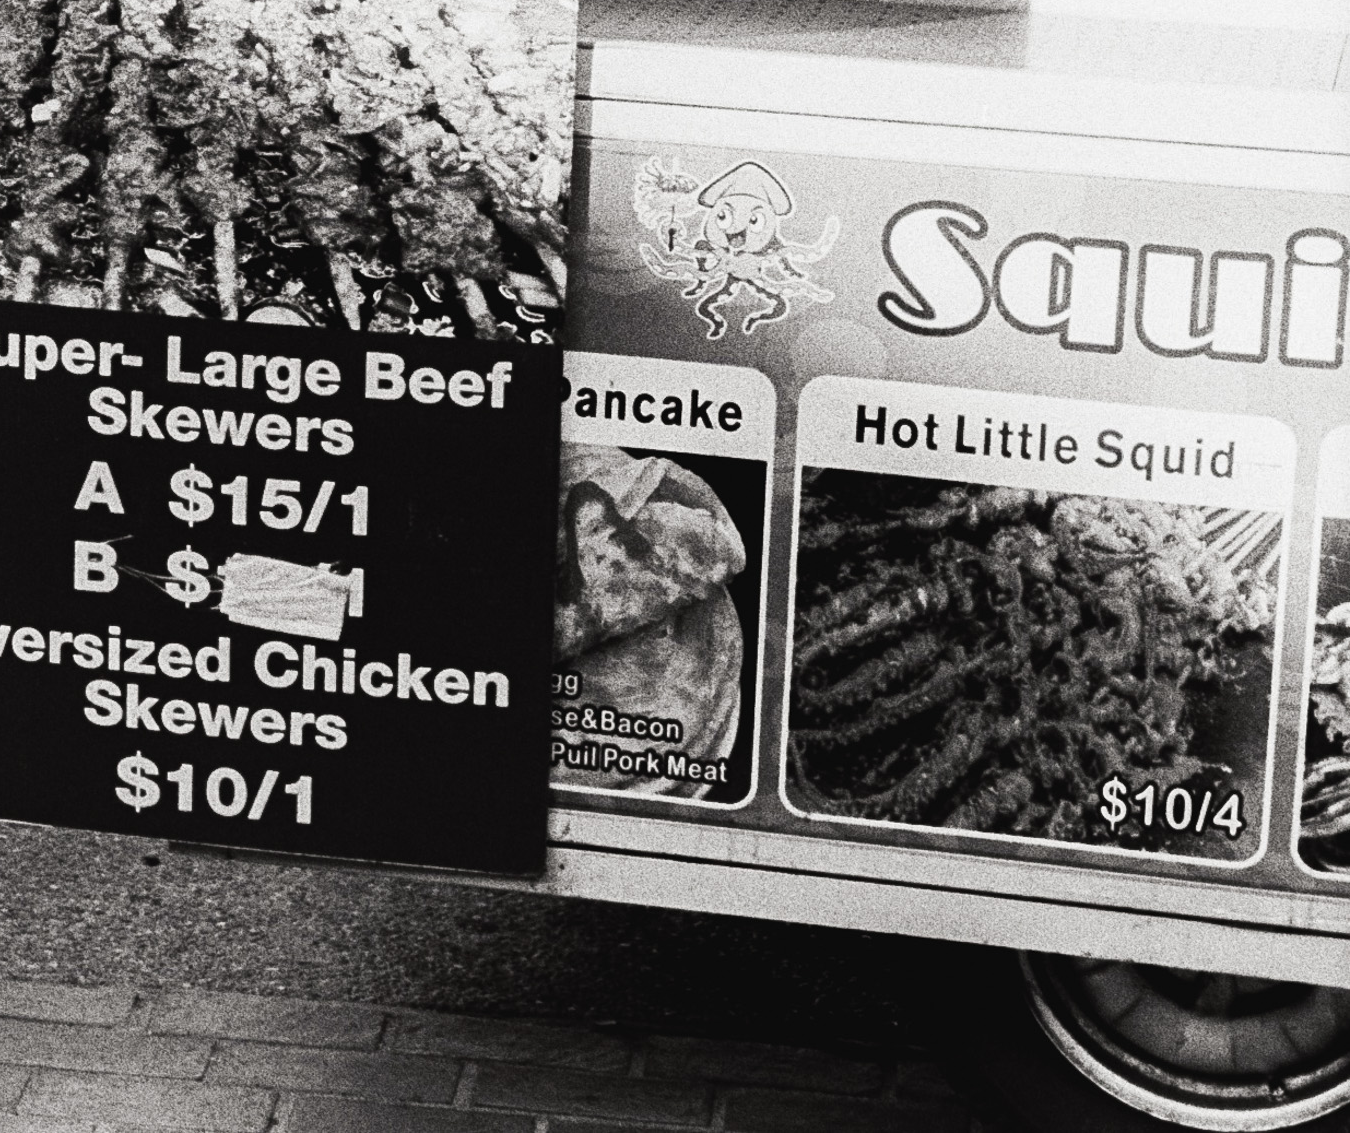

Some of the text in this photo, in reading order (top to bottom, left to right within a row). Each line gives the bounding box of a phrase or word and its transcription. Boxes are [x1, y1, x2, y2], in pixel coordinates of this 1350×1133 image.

[877, 199, 1350, 370] Squi
[166, 335, 342, 404] Large
[364, 351, 513, 409] Beef
[87, 386, 355, 456] Skewers
[855, 404, 1236, 482] Hot Little Squid
[73, 460, 369, 536] A $15/1
[73, 540, 120, 593] B
[253, 640, 510, 708] Chicken
[83, 679, 348, 750] Skewers
[114, 750, 313, 825] $10/1
[604, 748, 660, 774] Pork
[667, 755, 728, 783] Meat
[1100, 775, 1243, 836] $10/4
